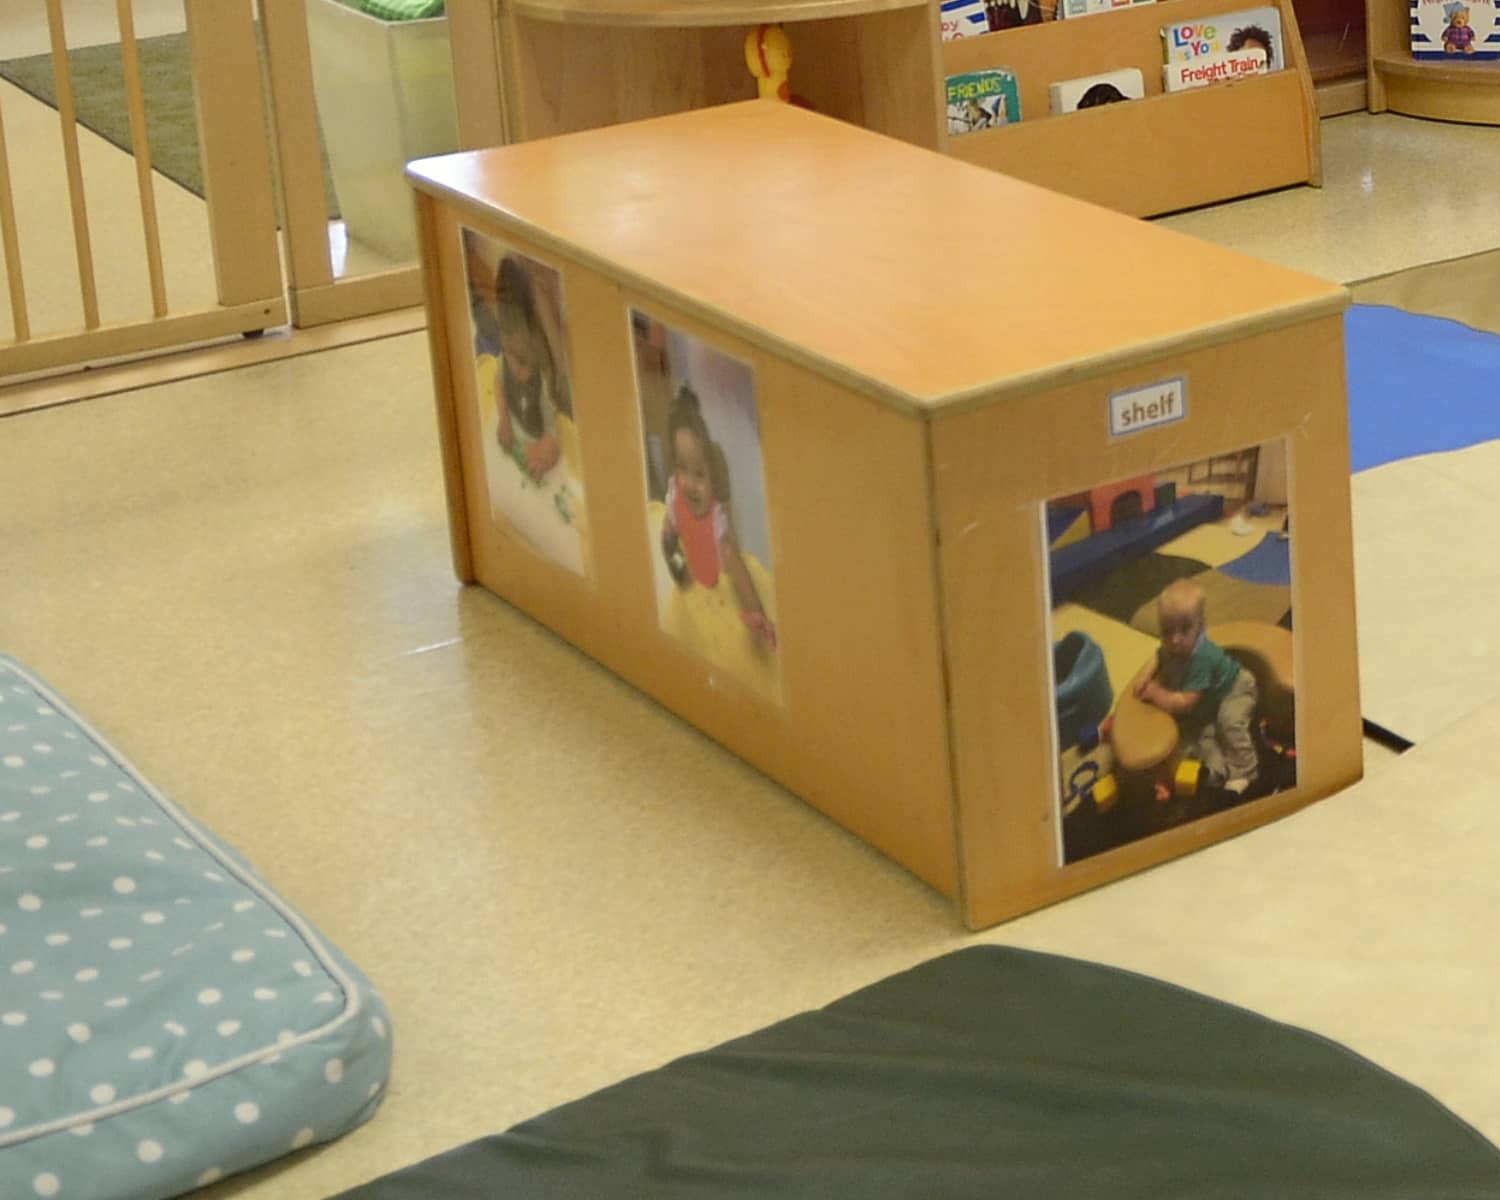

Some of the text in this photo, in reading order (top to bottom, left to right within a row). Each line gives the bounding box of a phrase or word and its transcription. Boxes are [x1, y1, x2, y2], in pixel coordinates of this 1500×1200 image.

[1173, 25, 1216, 48] Love
[1180, 57, 1258, 83] Freight Train
[1120, 392, 1175, 428] shelf
